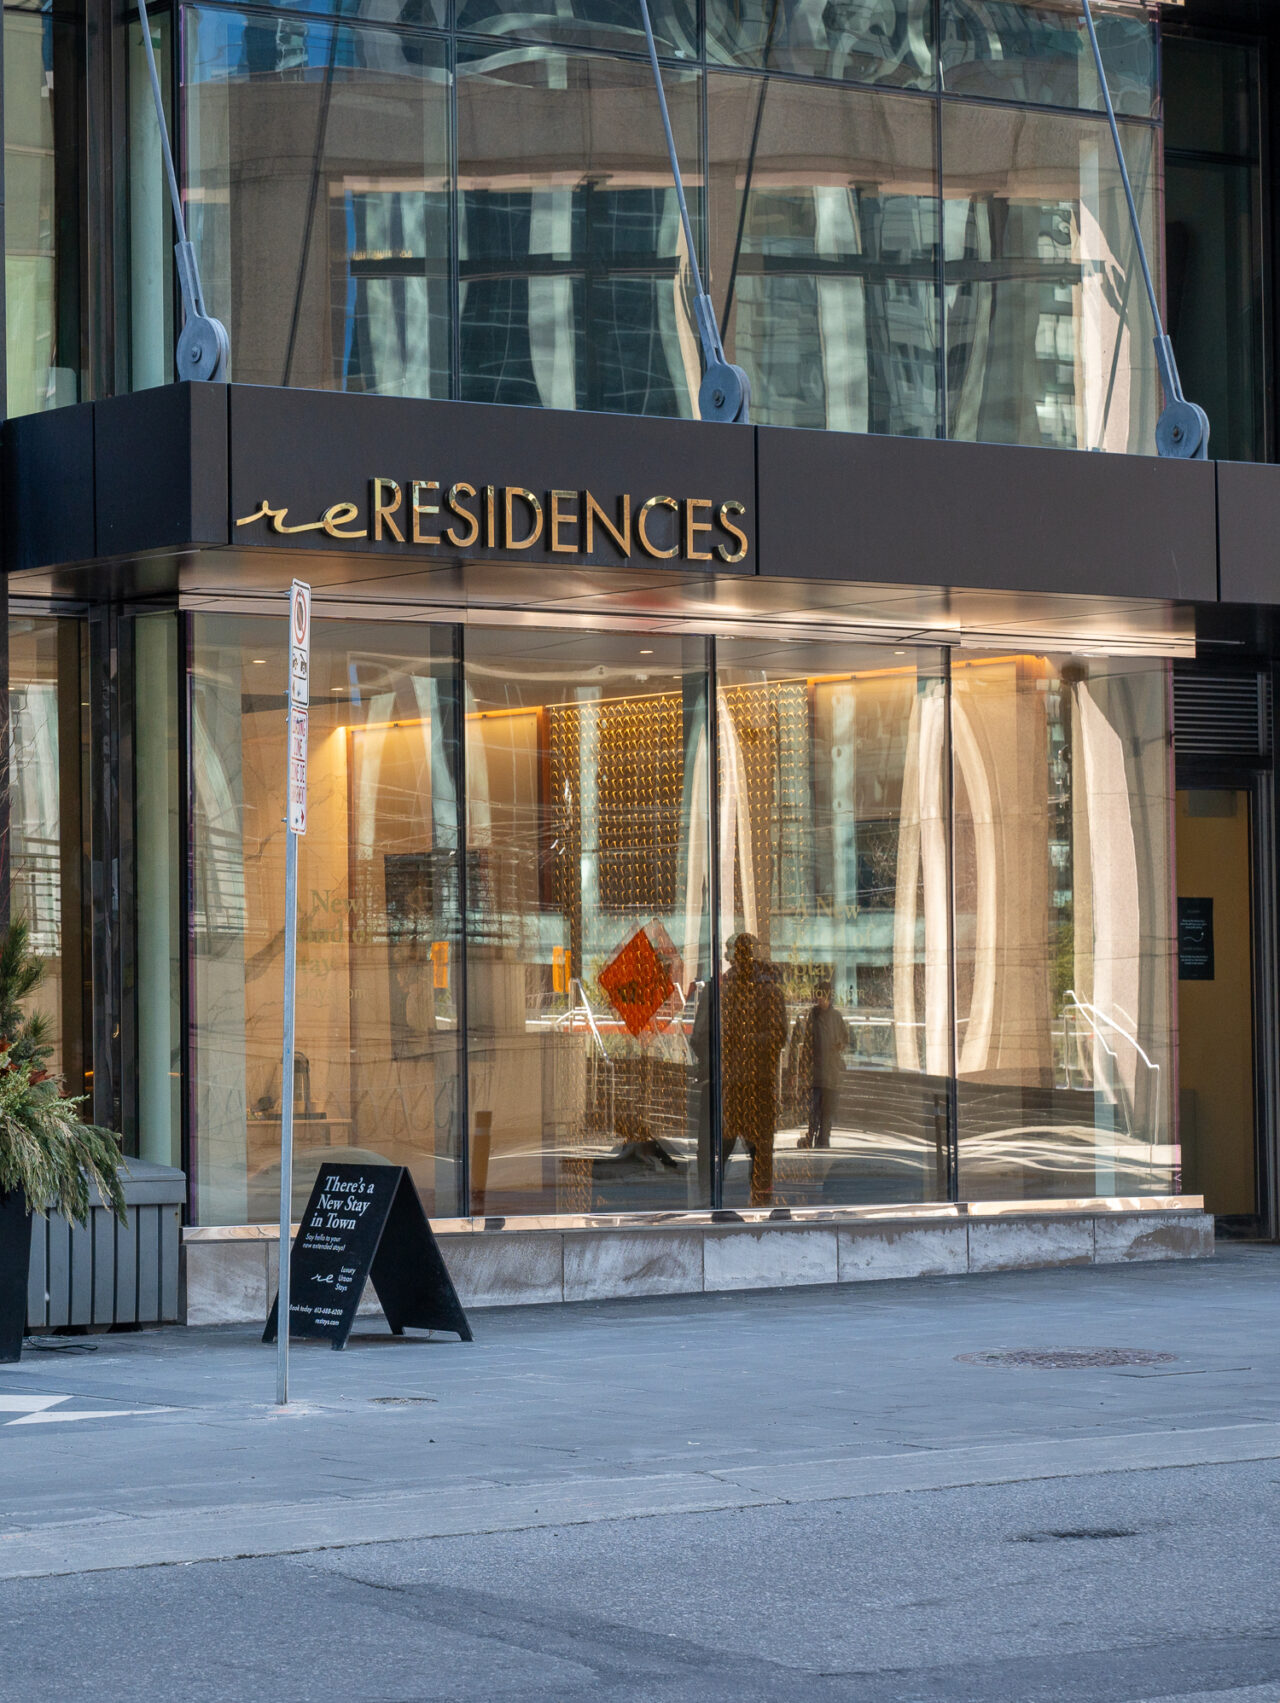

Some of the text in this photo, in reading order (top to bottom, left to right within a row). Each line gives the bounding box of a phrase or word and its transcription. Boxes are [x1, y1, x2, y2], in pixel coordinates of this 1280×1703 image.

[324, 1175, 375, 1194] There's a
[316, 1193, 371, 1216] New Stay
[310, 1212, 357, 1230] in Town
[305, 1232, 314, 1242] Say
[314, 1233, 326, 1241] hello
[312, 1242, 333, 1250] extended
[340, 1265, 357, 1275] Luxury
[310, 1273, 334, 1283] re
[334, 1282, 348, 1292] Stays
[300, 1304, 312, 1314] today
